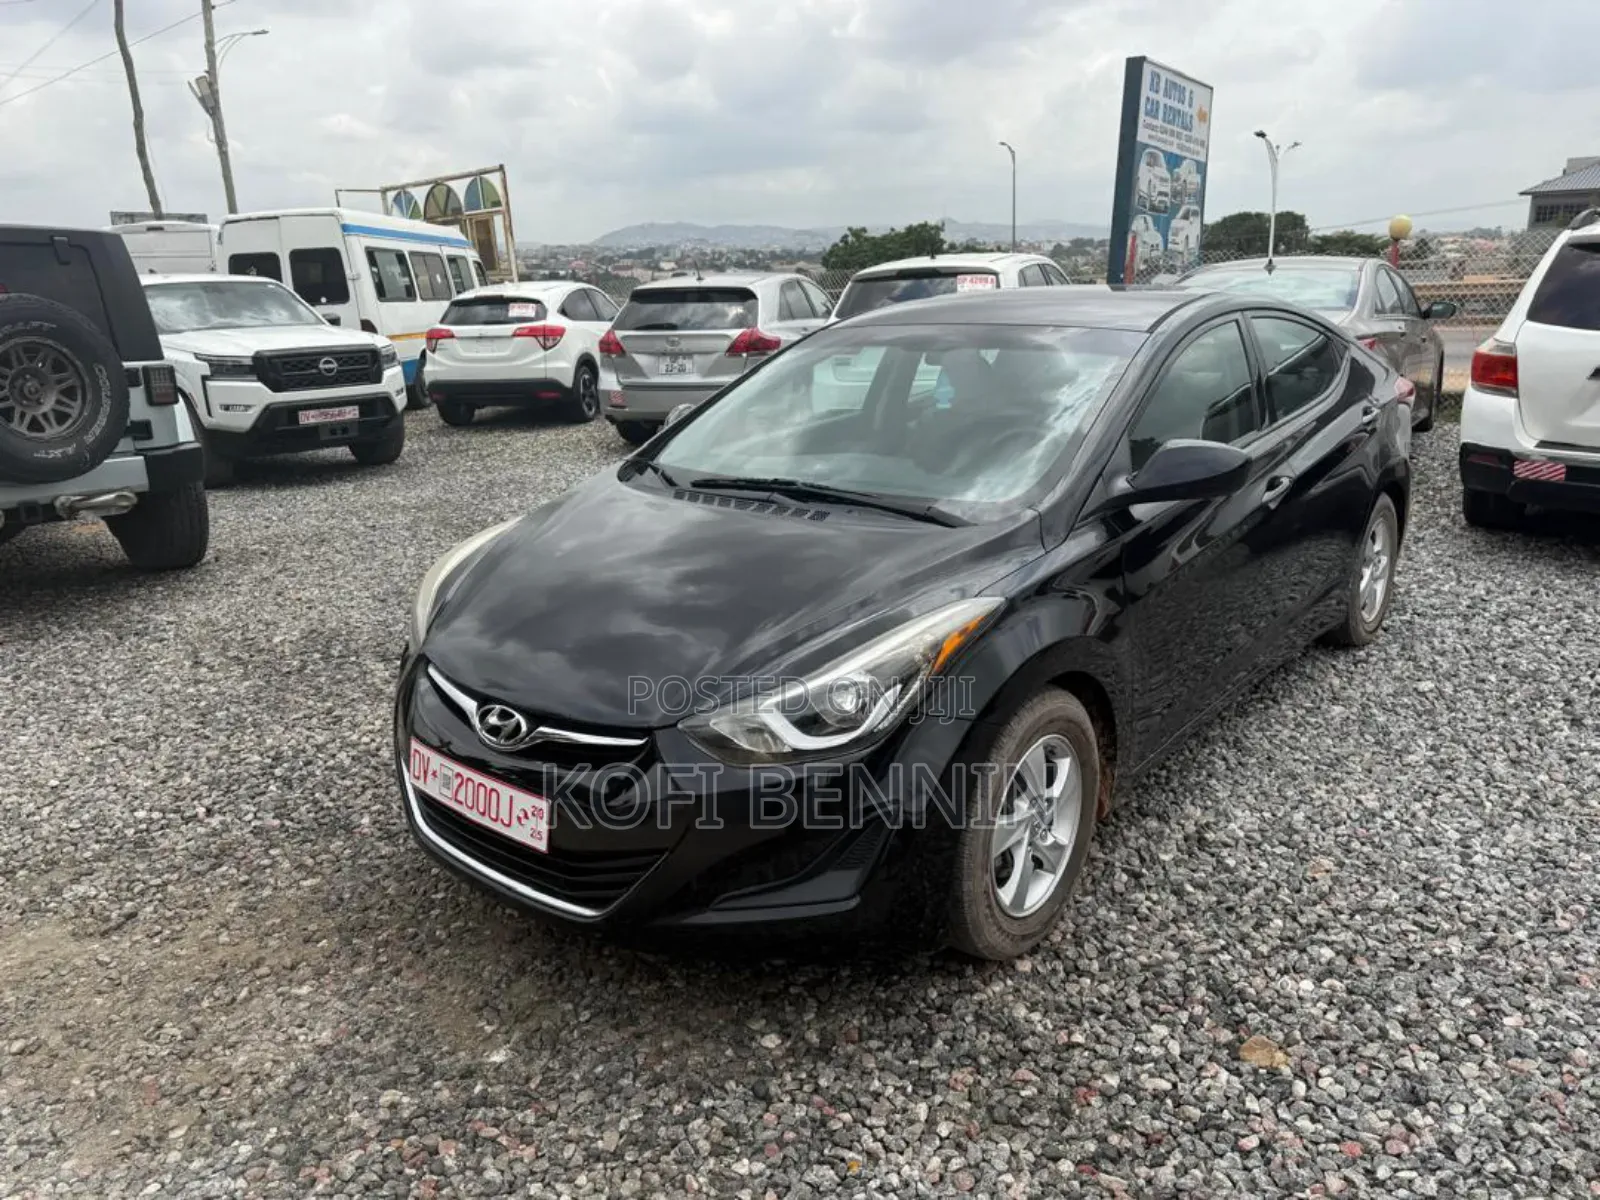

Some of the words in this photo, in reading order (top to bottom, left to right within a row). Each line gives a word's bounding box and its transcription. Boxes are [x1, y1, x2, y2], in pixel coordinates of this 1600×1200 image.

[1163, 78, 1186, 105] AUTOS
[1145, 96, 1160, 120] CAR
[1162, 103, 1193, 132] RENTALS
[412, 749, 430, 784] DV
[454, 772, 513, 828] 2000J
[531, 805, 544, 820] 20
[530, 827, 543, 841] 25
